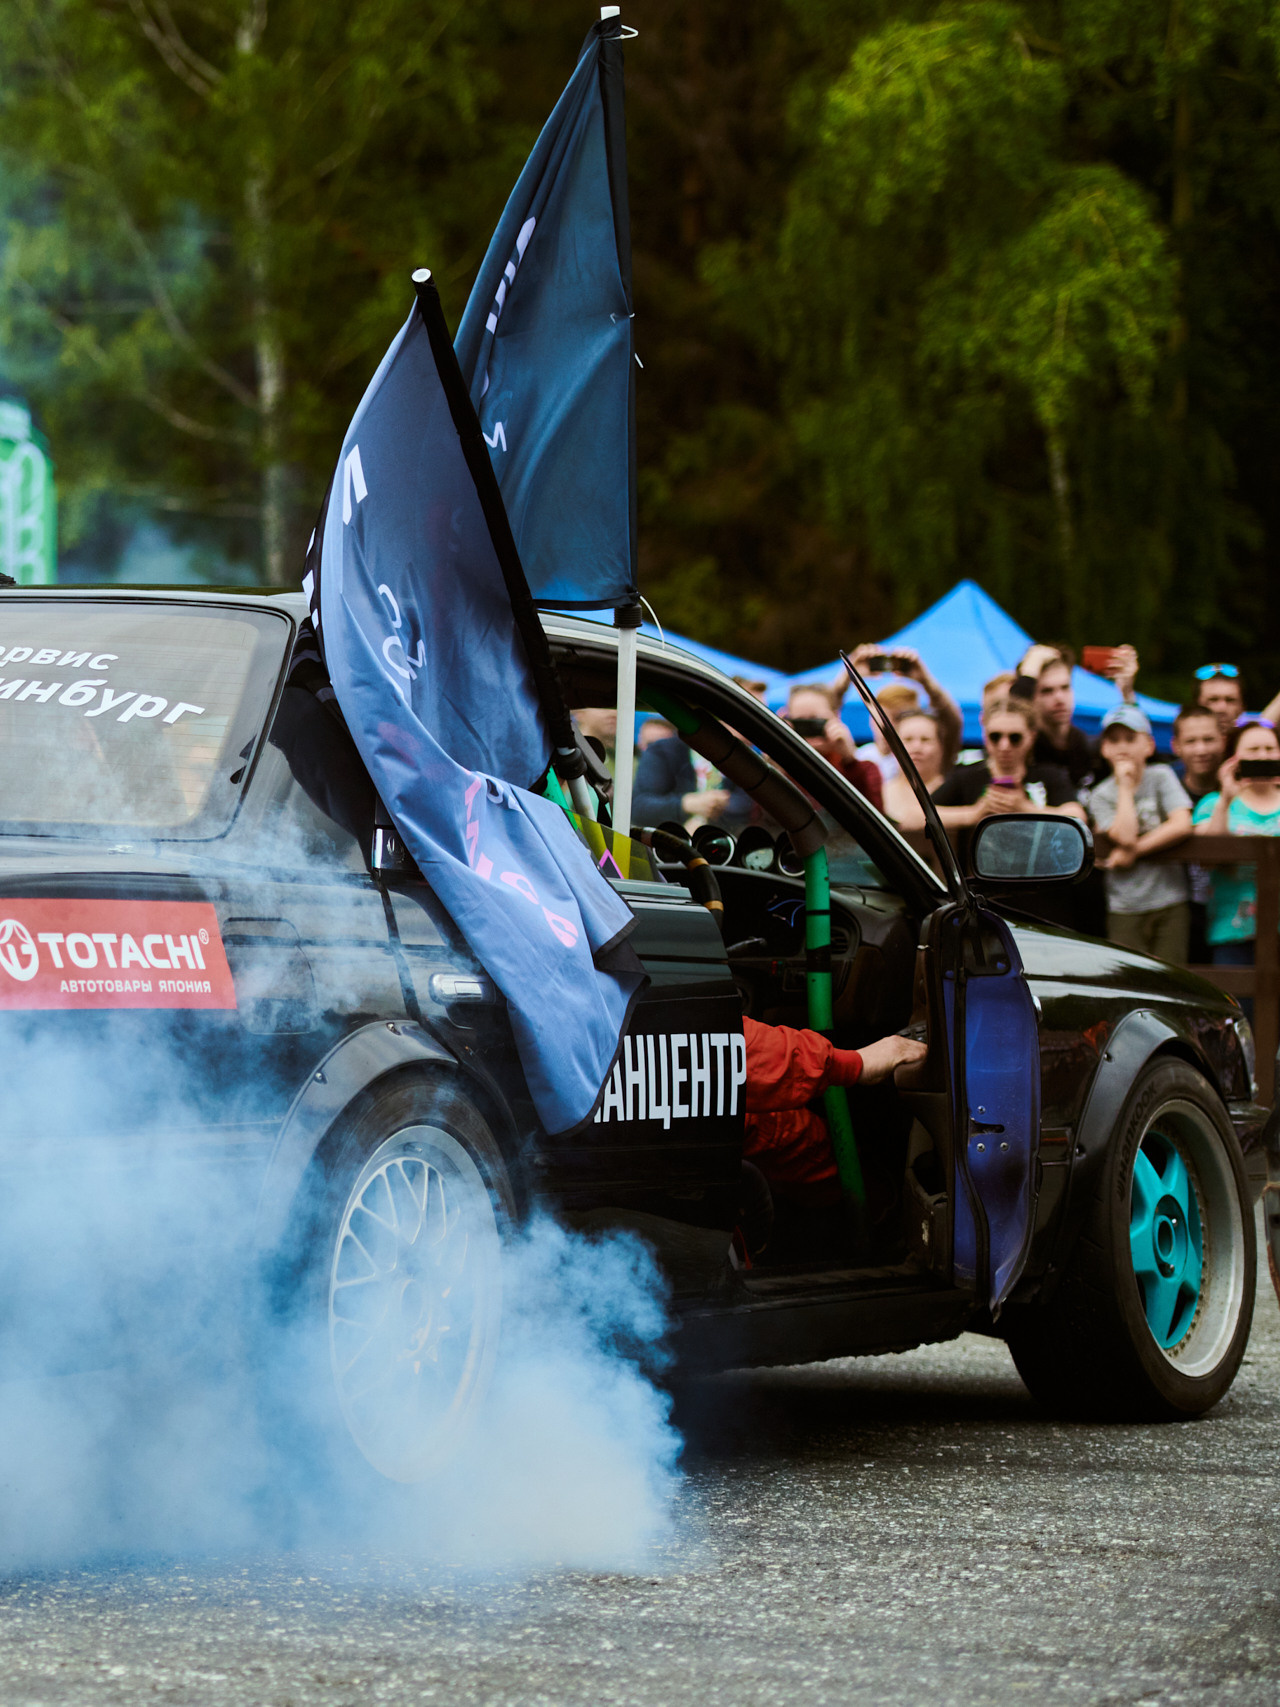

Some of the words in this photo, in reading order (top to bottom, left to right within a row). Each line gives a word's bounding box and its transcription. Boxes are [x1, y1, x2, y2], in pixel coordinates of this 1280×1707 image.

[60, 979, 153, 993] АВТОТОВАРЫ
[159, 980, 212, 993] ЯПОНИЯ
[593, 1033, 747, 1130] АНЦЕНТР
